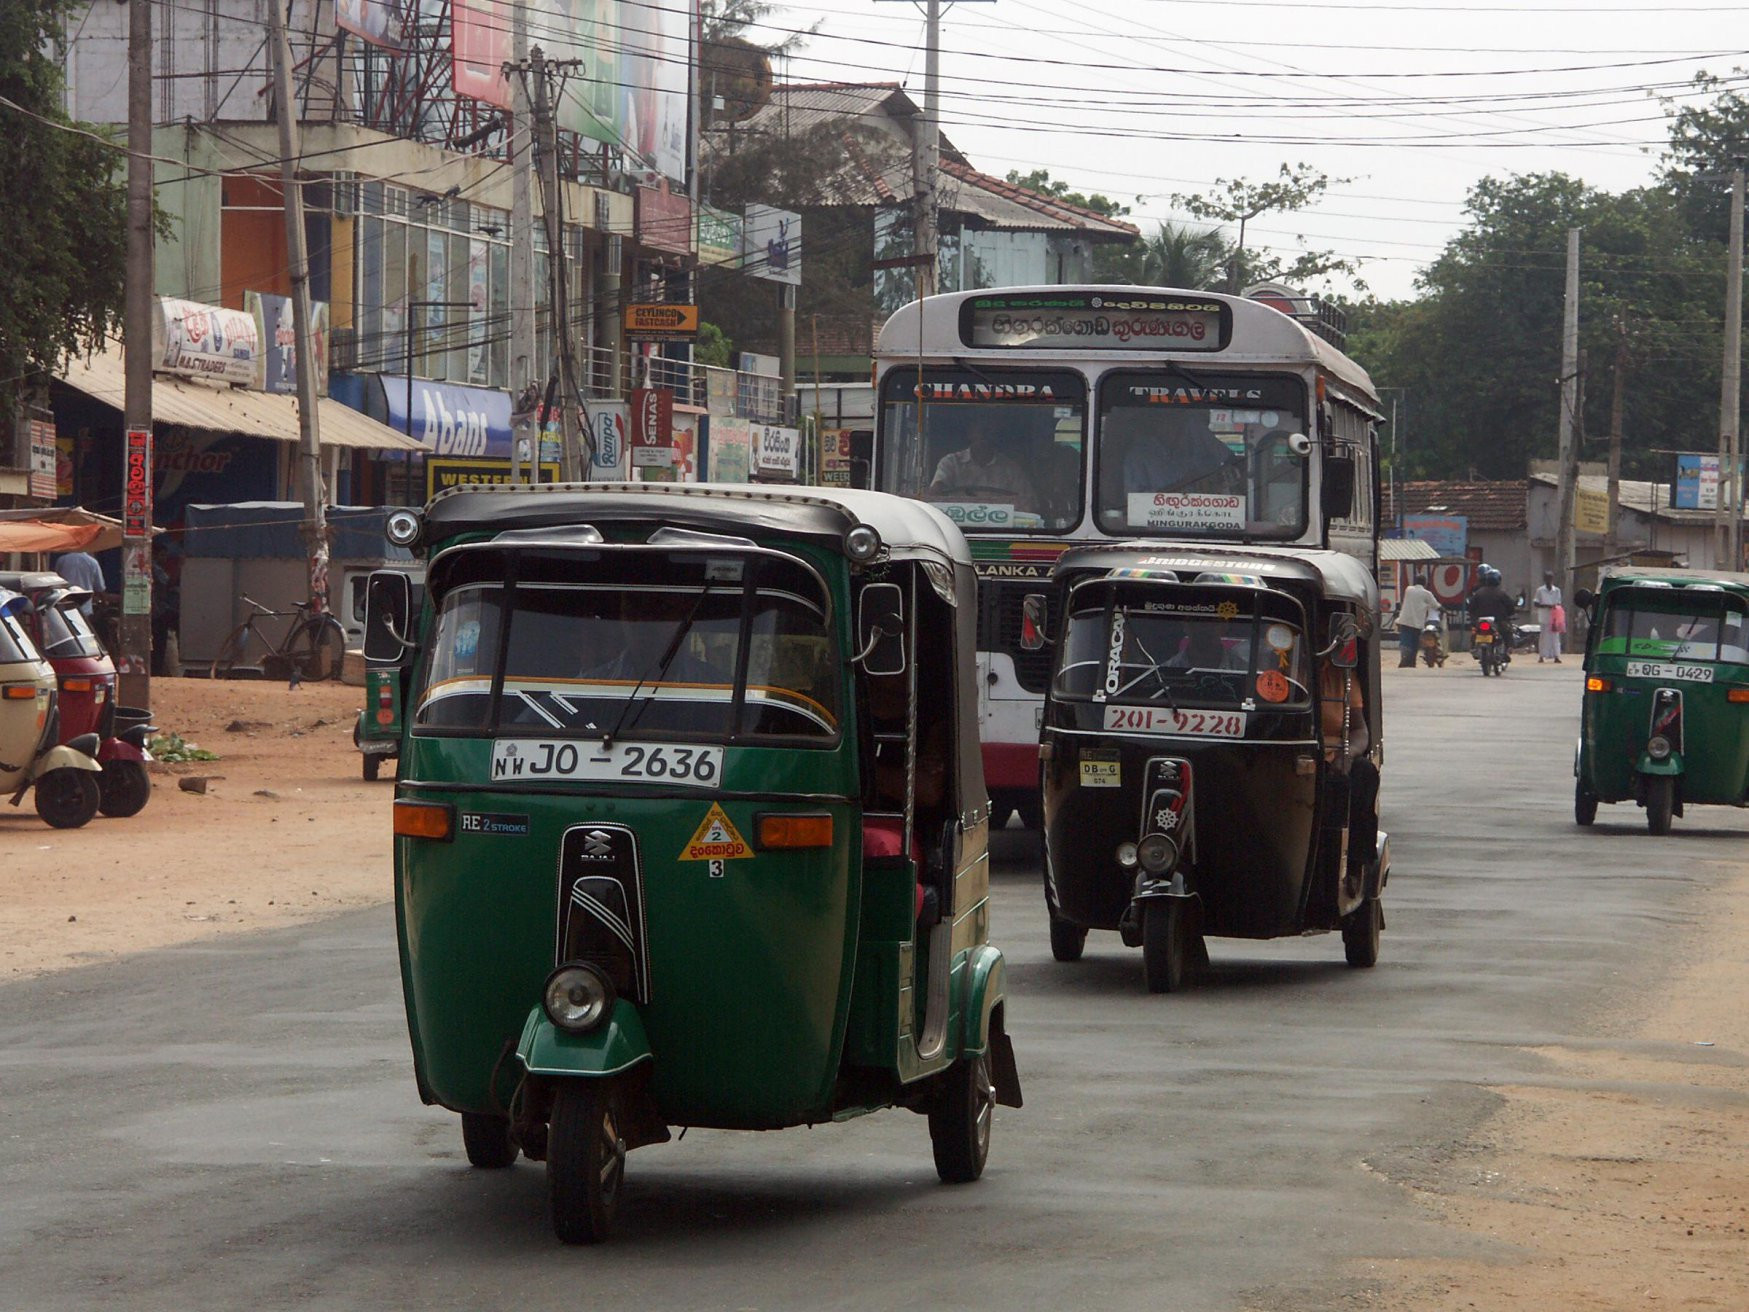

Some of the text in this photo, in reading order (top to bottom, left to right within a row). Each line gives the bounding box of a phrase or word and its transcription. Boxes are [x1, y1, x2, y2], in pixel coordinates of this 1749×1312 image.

[913, 382, 1263, 405] CHANDRA TRAVELS
[421, 389, 488, 456] Abans
[645, 392, 658, 446] SENAS
[601, 414, 617, 466] Ranpa
[154, 445, 232, 473] nchor
[1147, 519, 1241, 530] HINGURAKGODA
[974, 565, 1039, 577] LANKA
[1109, 708, 1241, 736] 201-9228
[494, 757, 524, 777] NW
[529, 744, 579, 775] JO
[620, 746, 717, 782] 2636
[462, 815, 481, 830] RE
[491, 823, 527, 833] STROKE
[711, 831, 722, 841] 2
[711, 860, 723, 877] 3
